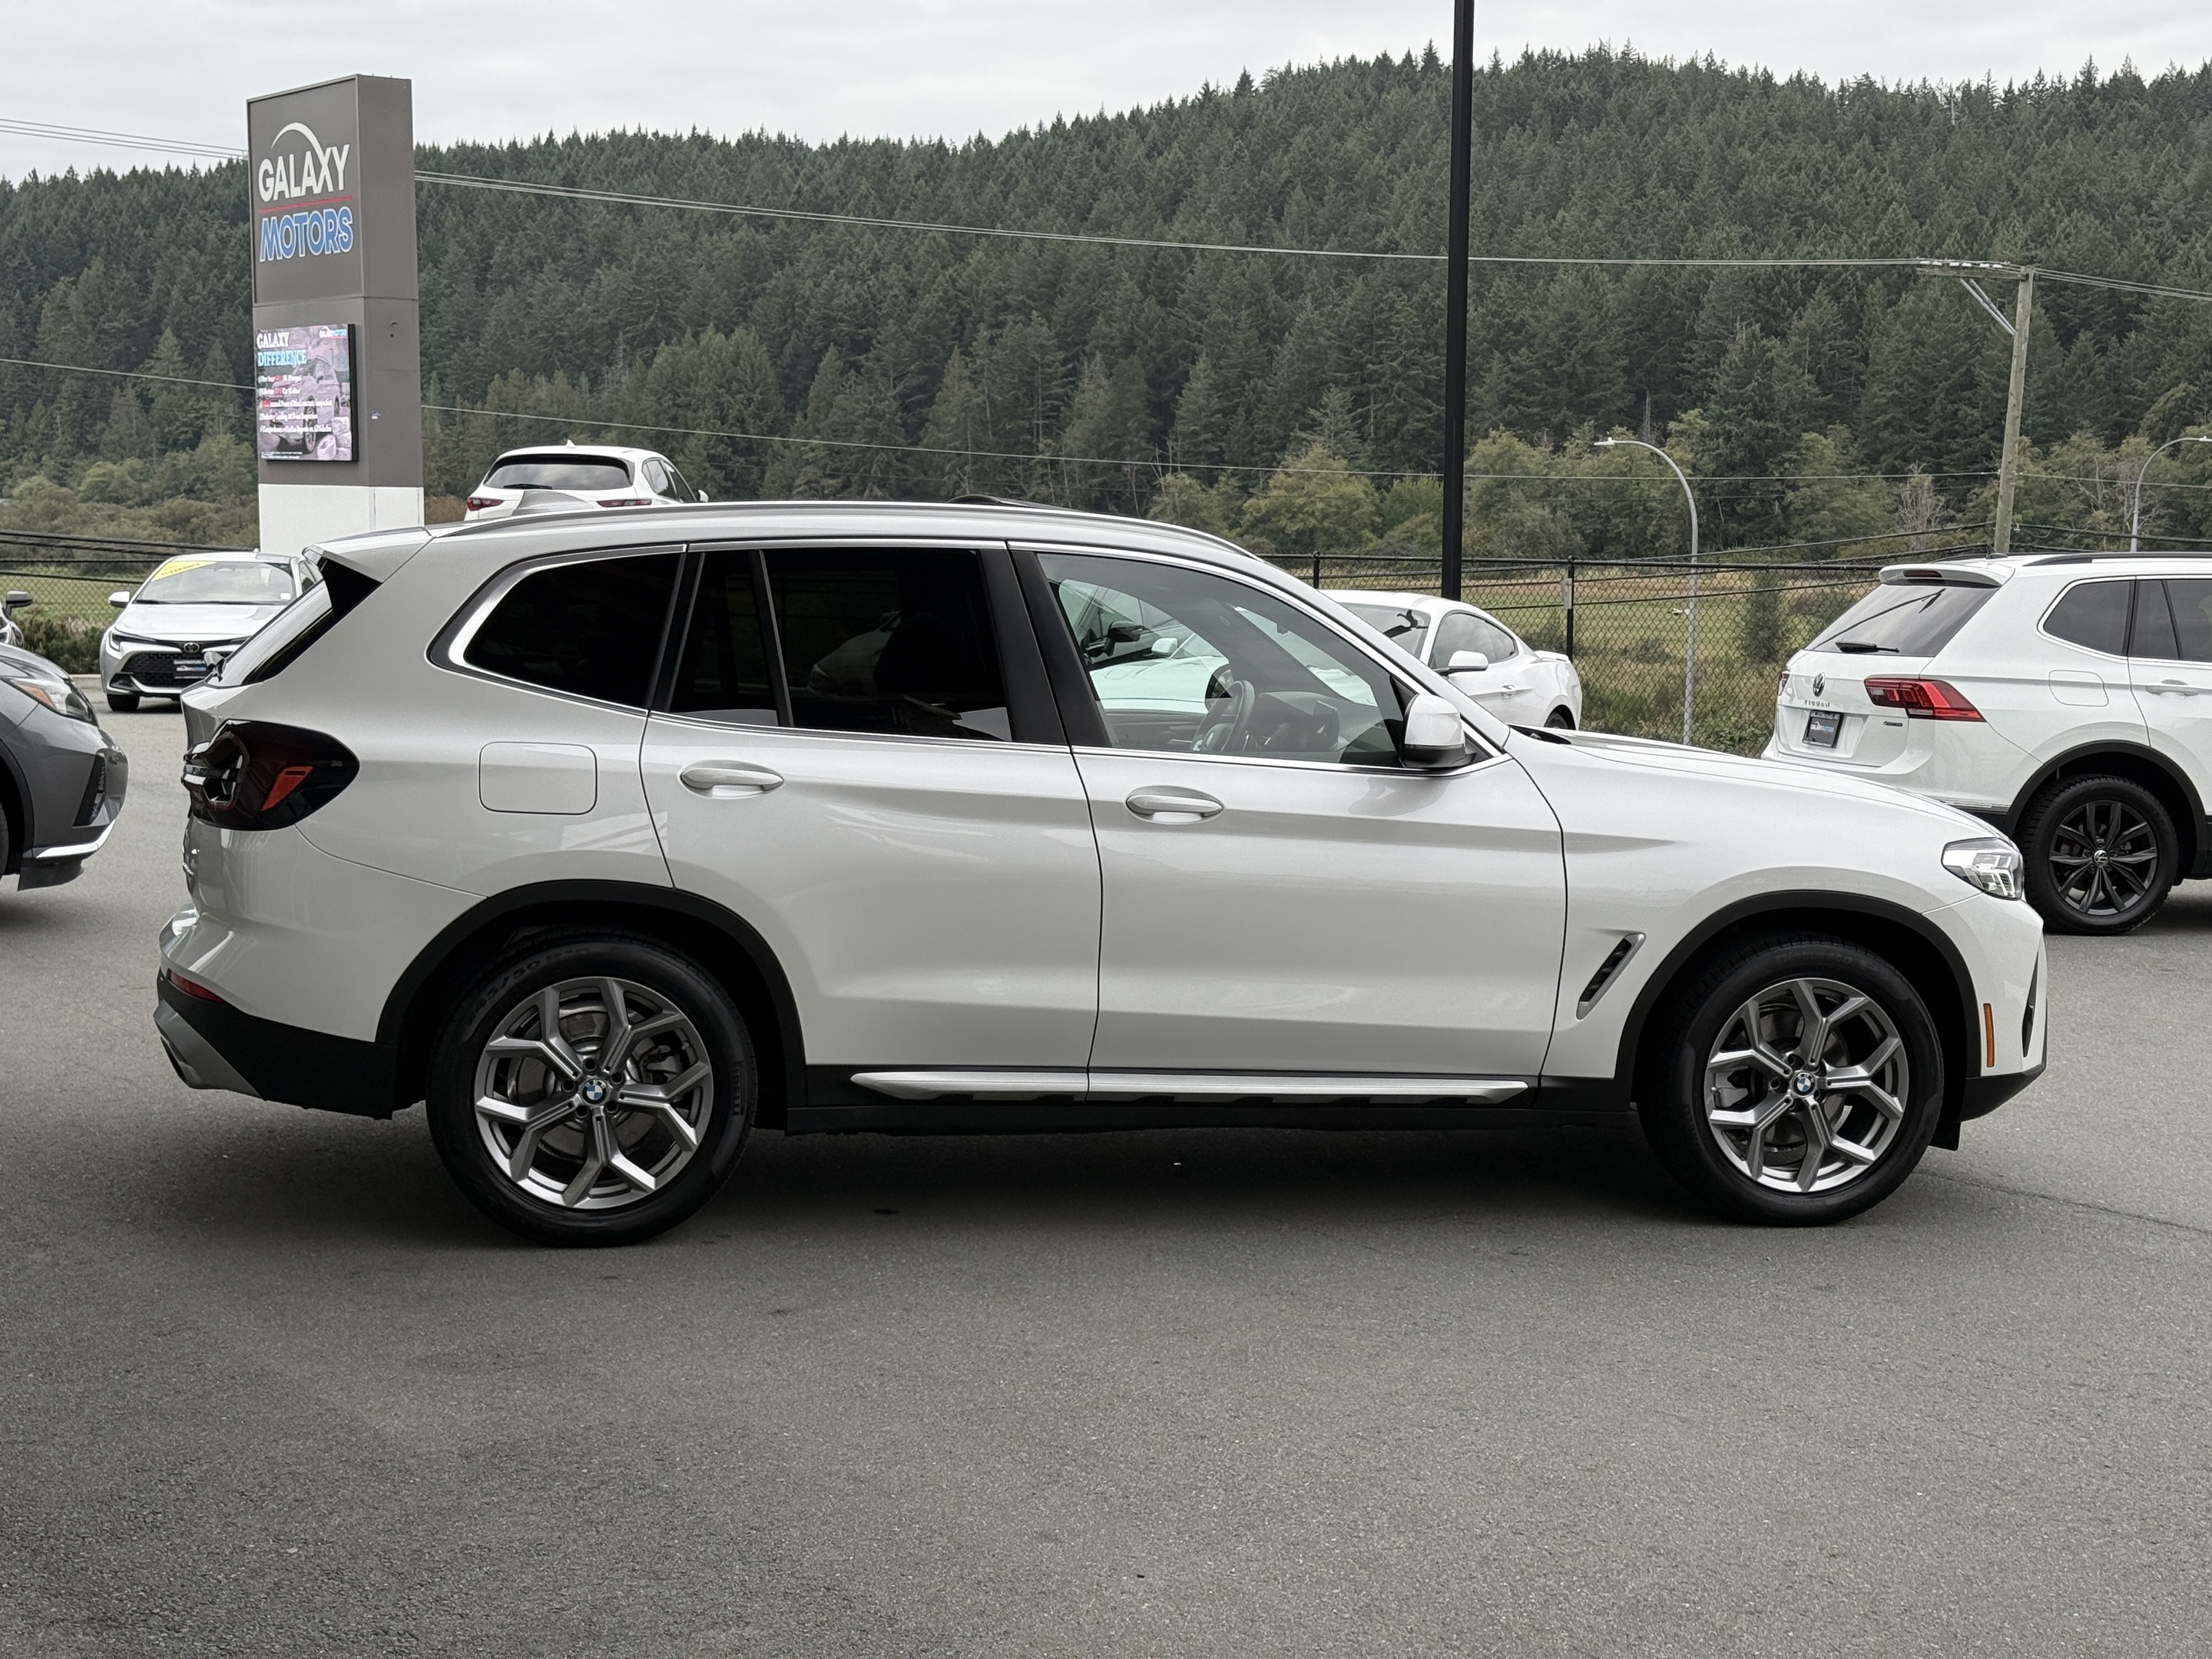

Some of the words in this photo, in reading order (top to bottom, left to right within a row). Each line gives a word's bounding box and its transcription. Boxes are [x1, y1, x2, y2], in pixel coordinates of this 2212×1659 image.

[259, 144, 349, 202] GALAXY
[260, 207, 353, 262] MOTORS
[256, 332, 290, 350] GALAXY
[257, 349, 307, 367] DIFFERENCE
